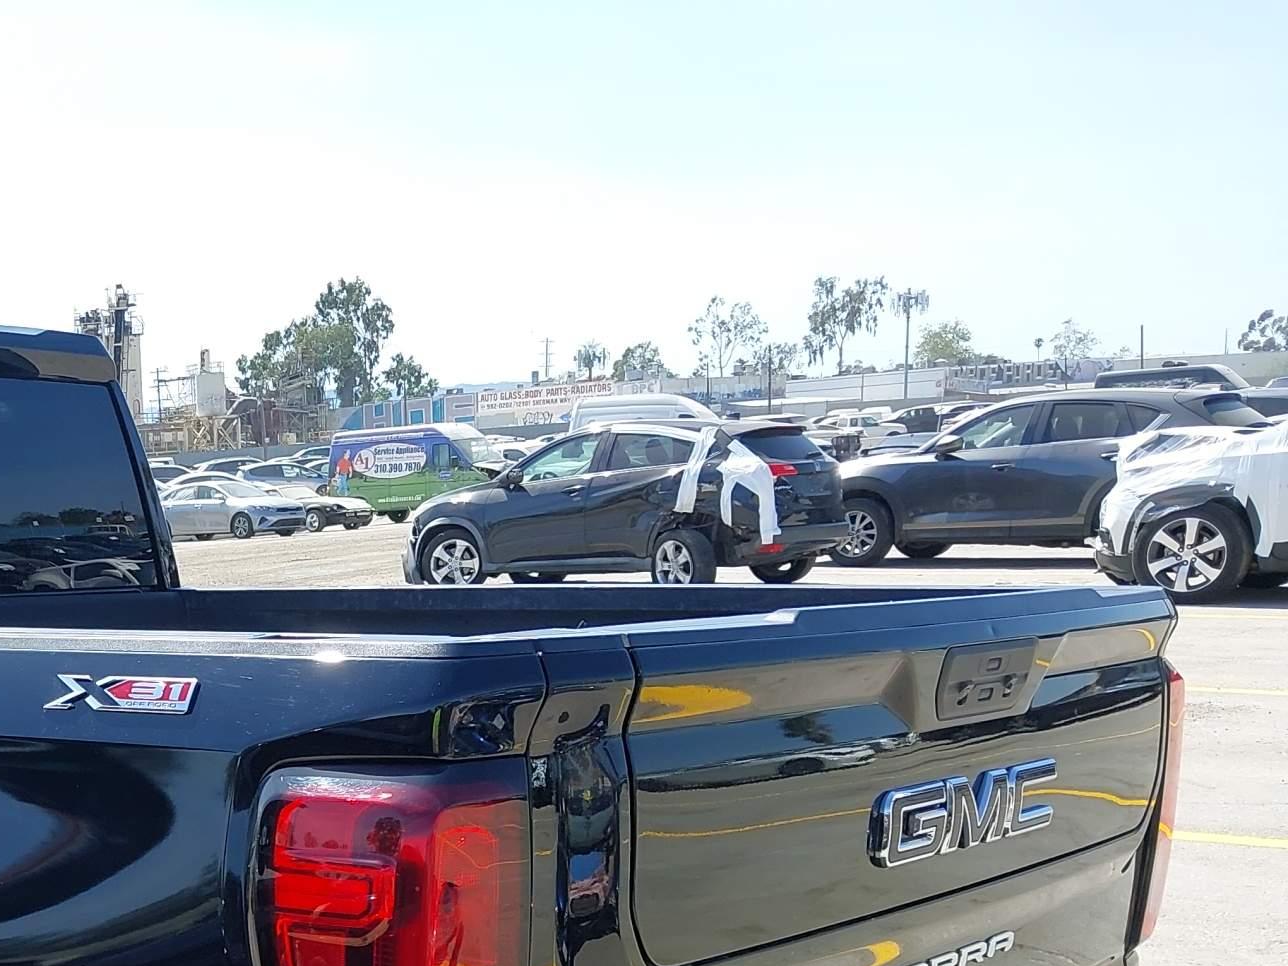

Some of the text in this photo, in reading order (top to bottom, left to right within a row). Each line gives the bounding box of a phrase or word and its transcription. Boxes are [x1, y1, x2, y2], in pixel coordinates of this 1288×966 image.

[480, 392, 498, 402] AUTO
[374, 446, 424, 456] Service Appliance
[355, 453, 369, 469] A1
[866, 758, 1058, 868] GMC
